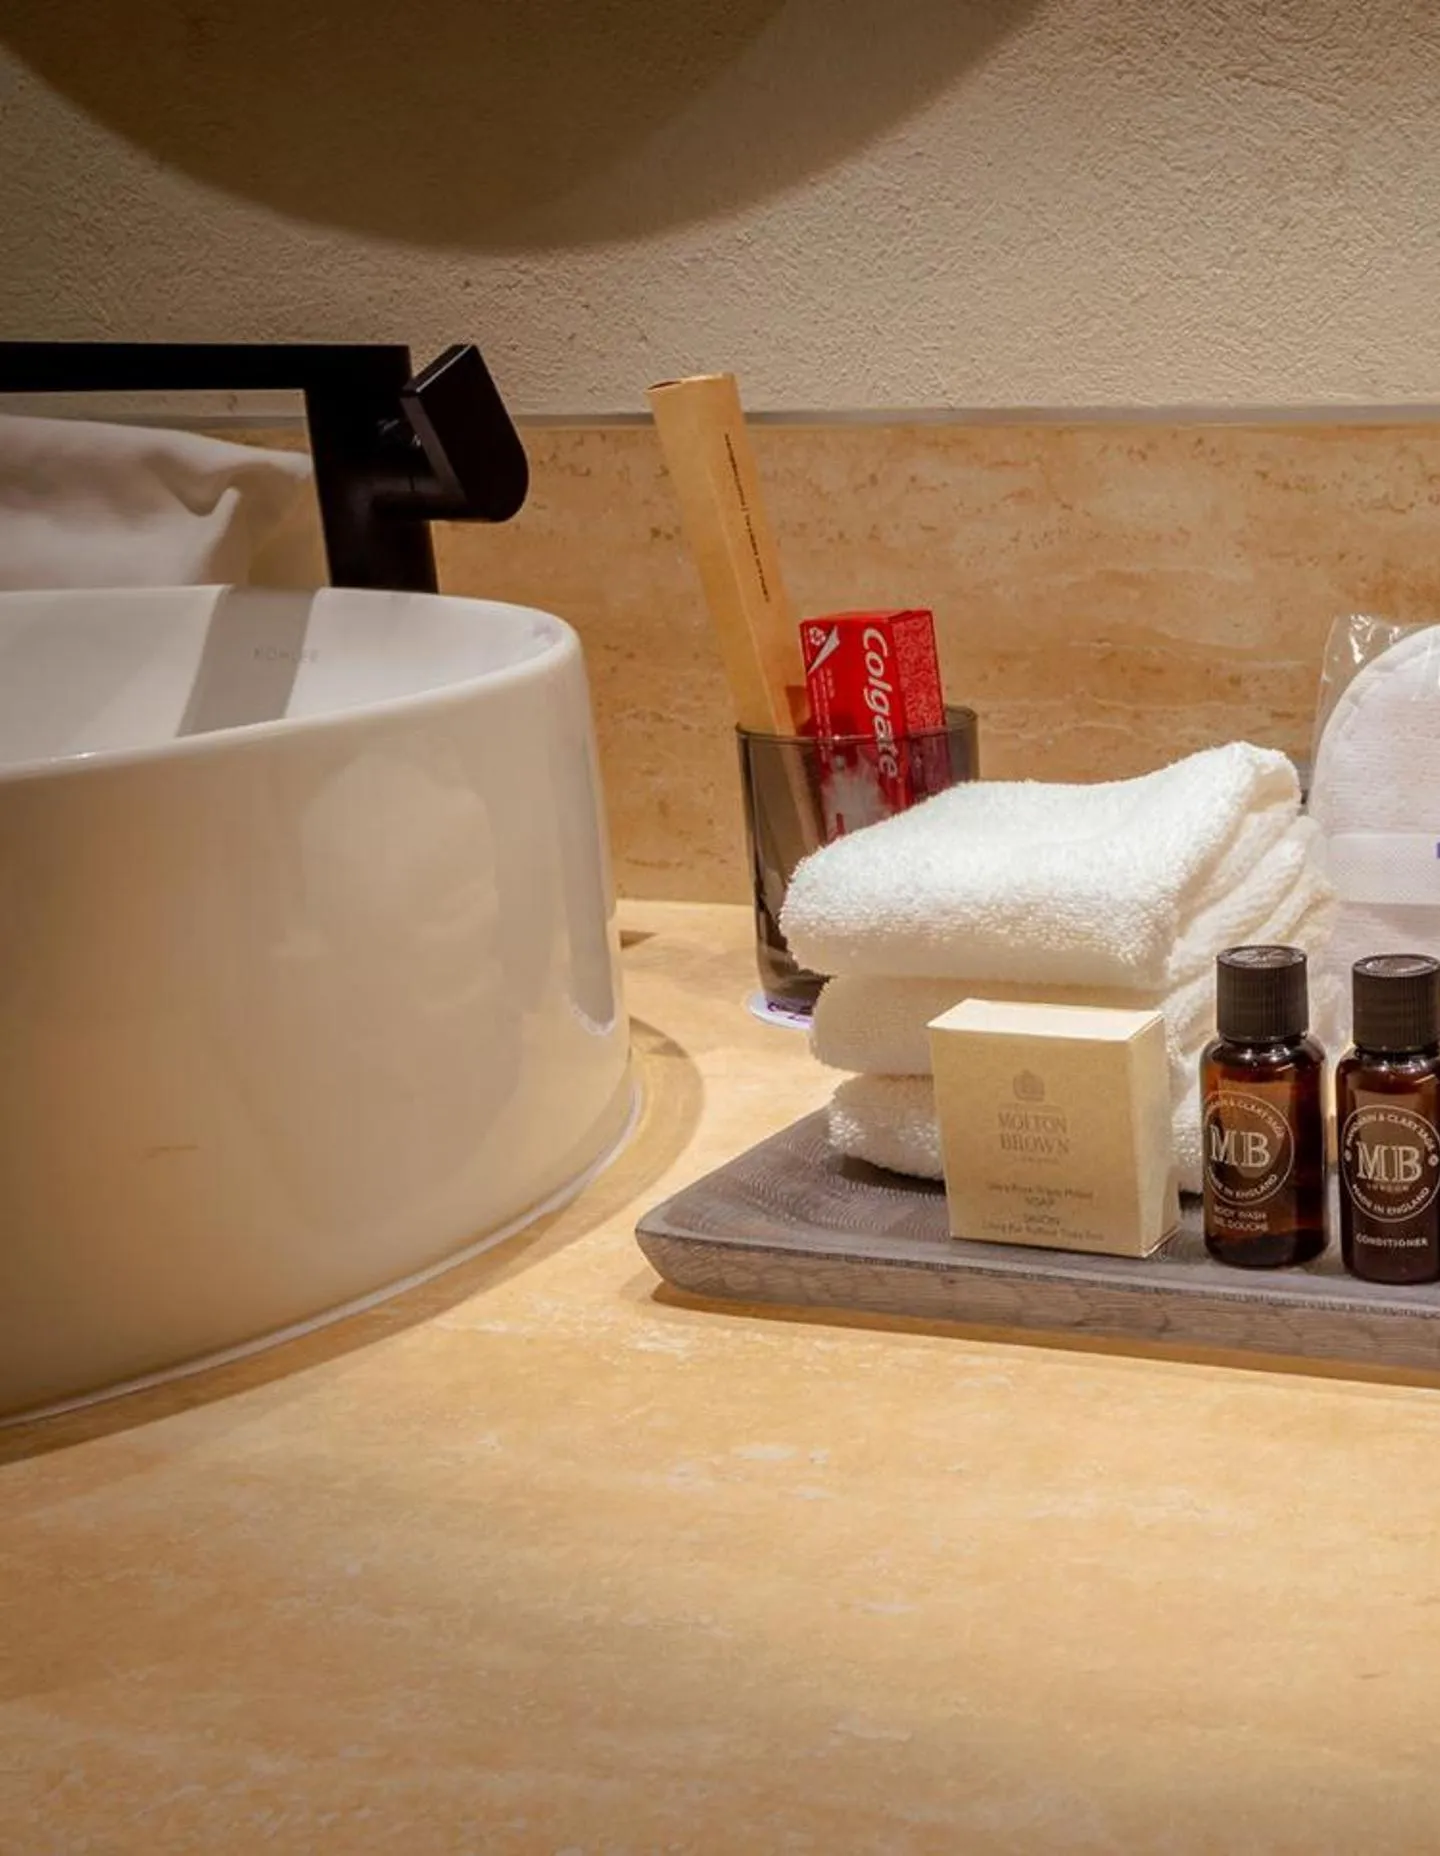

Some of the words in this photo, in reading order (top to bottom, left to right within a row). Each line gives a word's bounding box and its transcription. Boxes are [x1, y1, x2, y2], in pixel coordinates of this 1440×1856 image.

[863, 627, 899, 778] Colgate
[1209, 1124, 1272, 1168] MB
[1355, 1140, 1422, 1184] MB
[1235, 1173, 1279, 1199] ENGLAND
[1238, 1208, 1267, 1220] WASH
[1373, 1204, 1385, 1214] IN
[1386, 1187, 1430, 1215] ENGLAND
[1355, 1232, 1429, 1248] CONDITIONER
